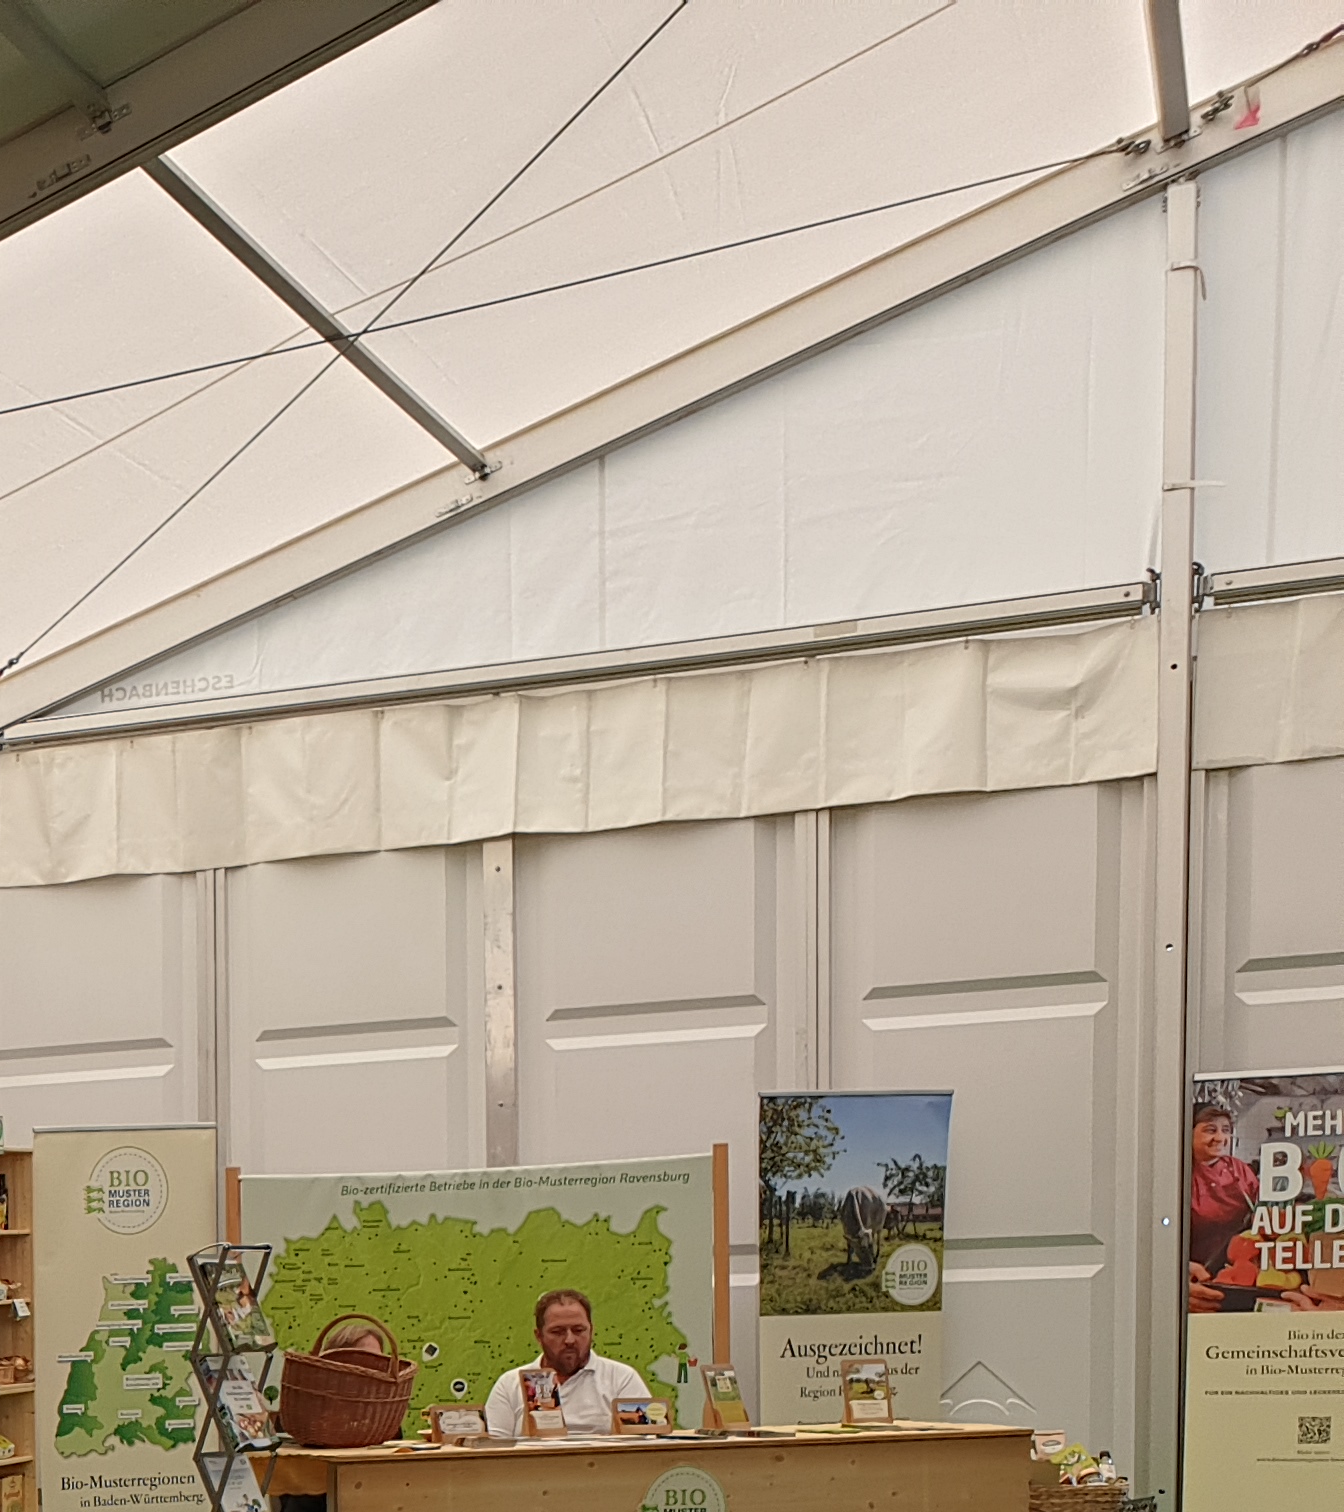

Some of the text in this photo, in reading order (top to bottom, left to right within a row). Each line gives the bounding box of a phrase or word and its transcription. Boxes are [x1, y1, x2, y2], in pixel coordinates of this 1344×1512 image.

[1284, 1109, 1343, 1138] MEH
[108, 1169, 149, 1188] BIO
[341, 1171, 690, 1196] Bio-zertifizierte Betriebe in der Bio-Musterregion Ravensburg
[108, 1188, 150, 1199] MUSTER
[108, 1198, 150, 1209] REGION
[1251, 1204, 1344, 1235] AUF D
[1255, 1240, 1344, 1270] TELLE
[900, 1259, 928, 1272] BIO
[898, 1272, 928, 1280] MUSTER
[1287, 1330, 1309, 1340] Bio
[1312, 1330, 1323, 1340] in
[780, 1333, 922, 1365] Ausgezeichnet!
[1205, 1344, 1344, 1360] Gemeinschaftsve
[806, 1366, 830, 1378] Und
[900, 1363, 920, 1375] der
[1246, 1365, 1257, 1376] in
[800, 1385, 836, 1401] Region
[61, 1472, 195, 1491] Bio-Musterregionen
[80, 1496, 90, 1507] in
[664, 1489, 707, 1506] BIO
